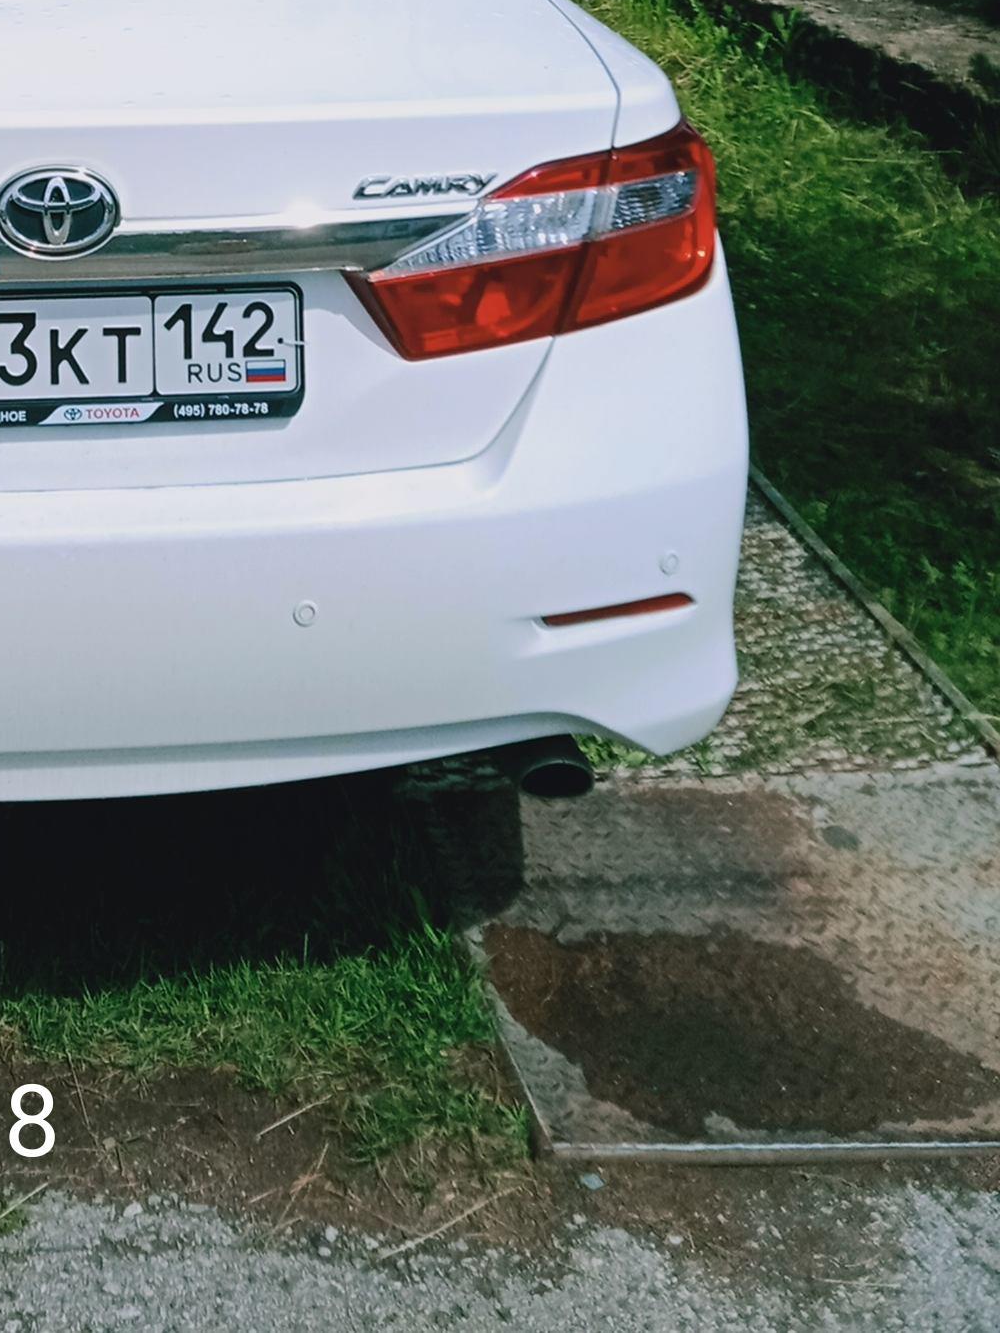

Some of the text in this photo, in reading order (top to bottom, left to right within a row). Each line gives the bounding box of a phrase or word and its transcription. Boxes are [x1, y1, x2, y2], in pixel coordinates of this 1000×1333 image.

[352, 172, 499, 200] CAMRY
[163, 301, 276, 360] 142
[187, 362, 242, 384] RUS
[86, 408, 140, 420] TOYOTA
[173, 402, 270, 419] (495) 780-78-78
